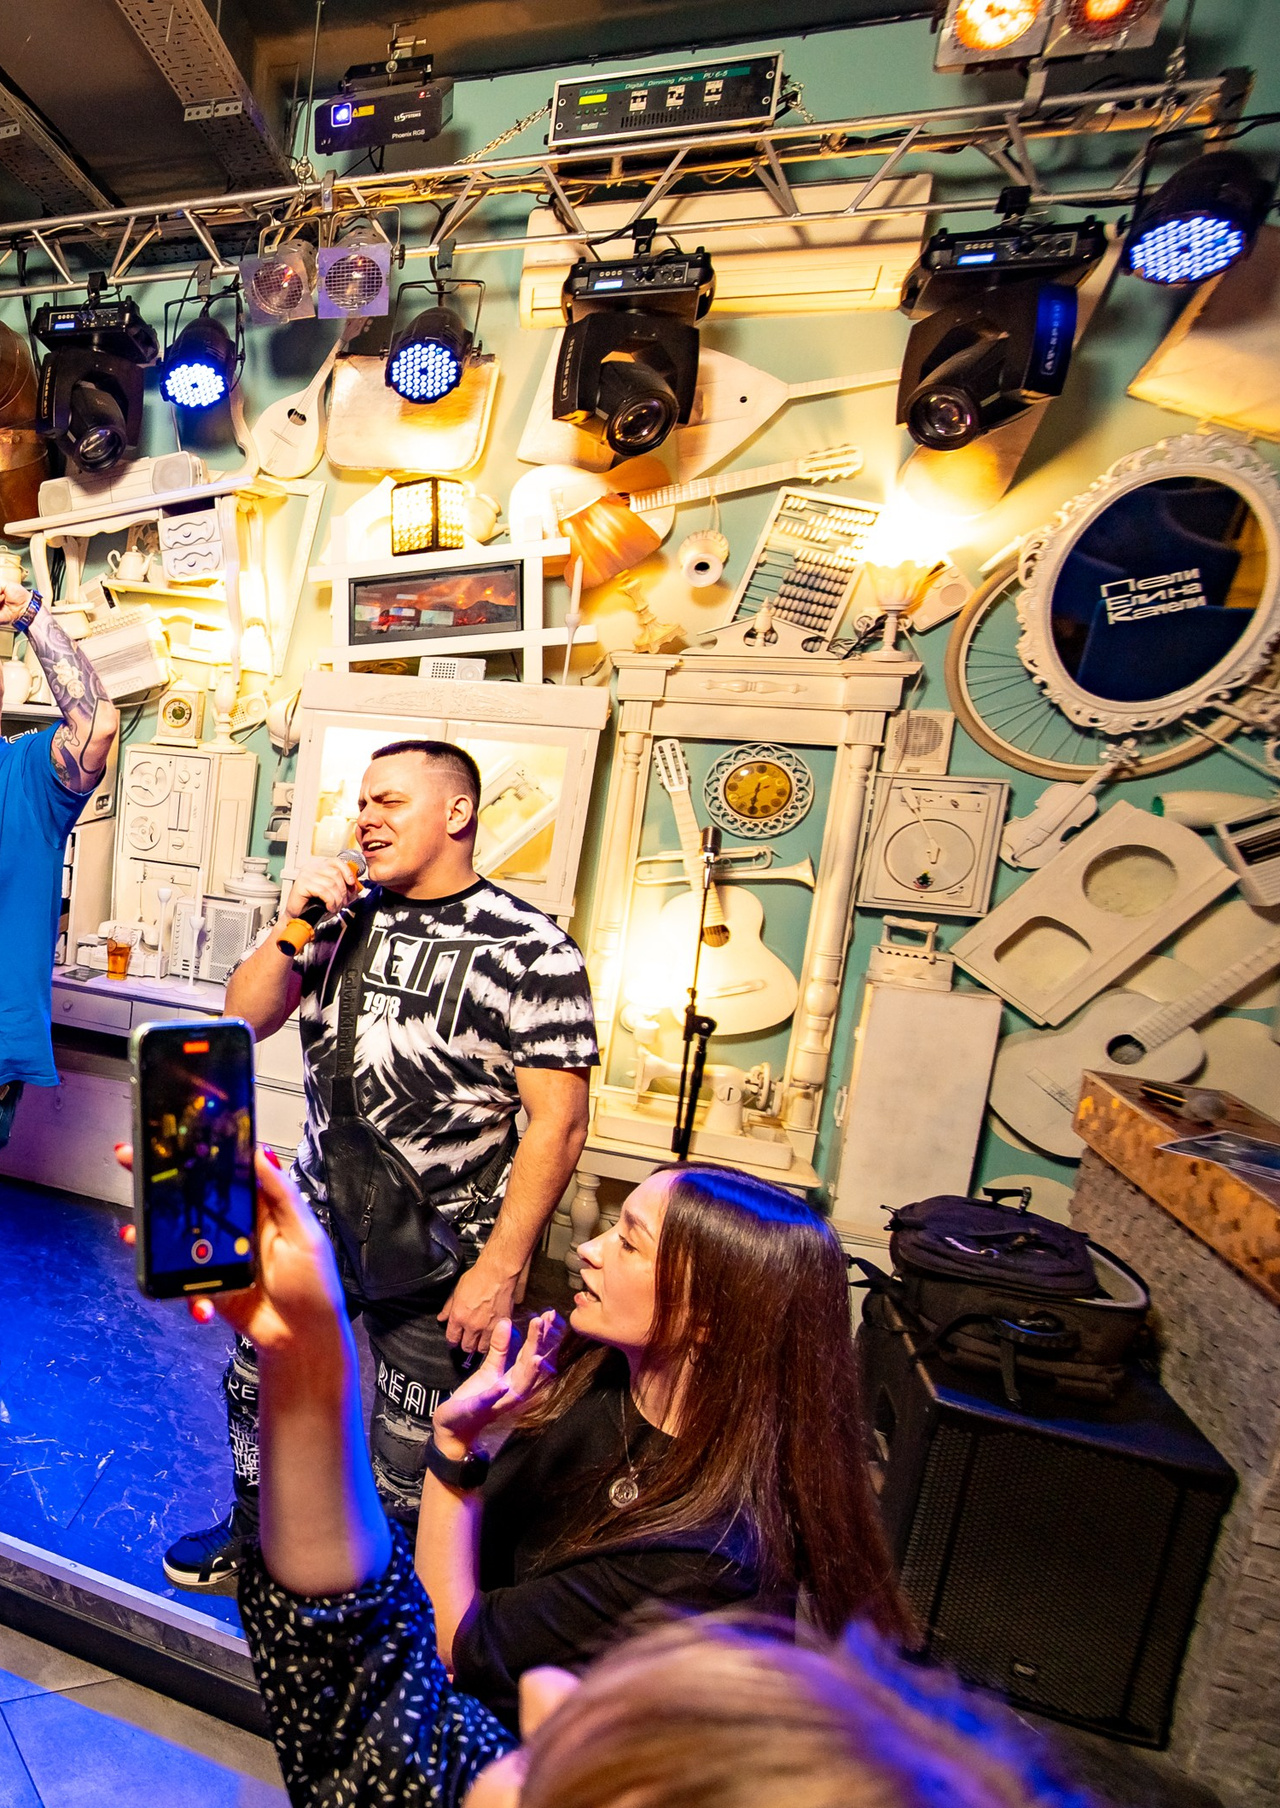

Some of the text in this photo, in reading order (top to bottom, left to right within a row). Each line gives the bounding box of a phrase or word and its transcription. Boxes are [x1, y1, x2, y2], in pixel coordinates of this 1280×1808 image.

[624, 81, 645, 90] Digital
[647, 78, 675, 87] Dimming
[391, 131, 412, 139] Phoenix
[1100, 568, 1200, 597] Пели
[1107, 595, 1207, 625] Качели
[377, 1360, 453, 1417] REAL
